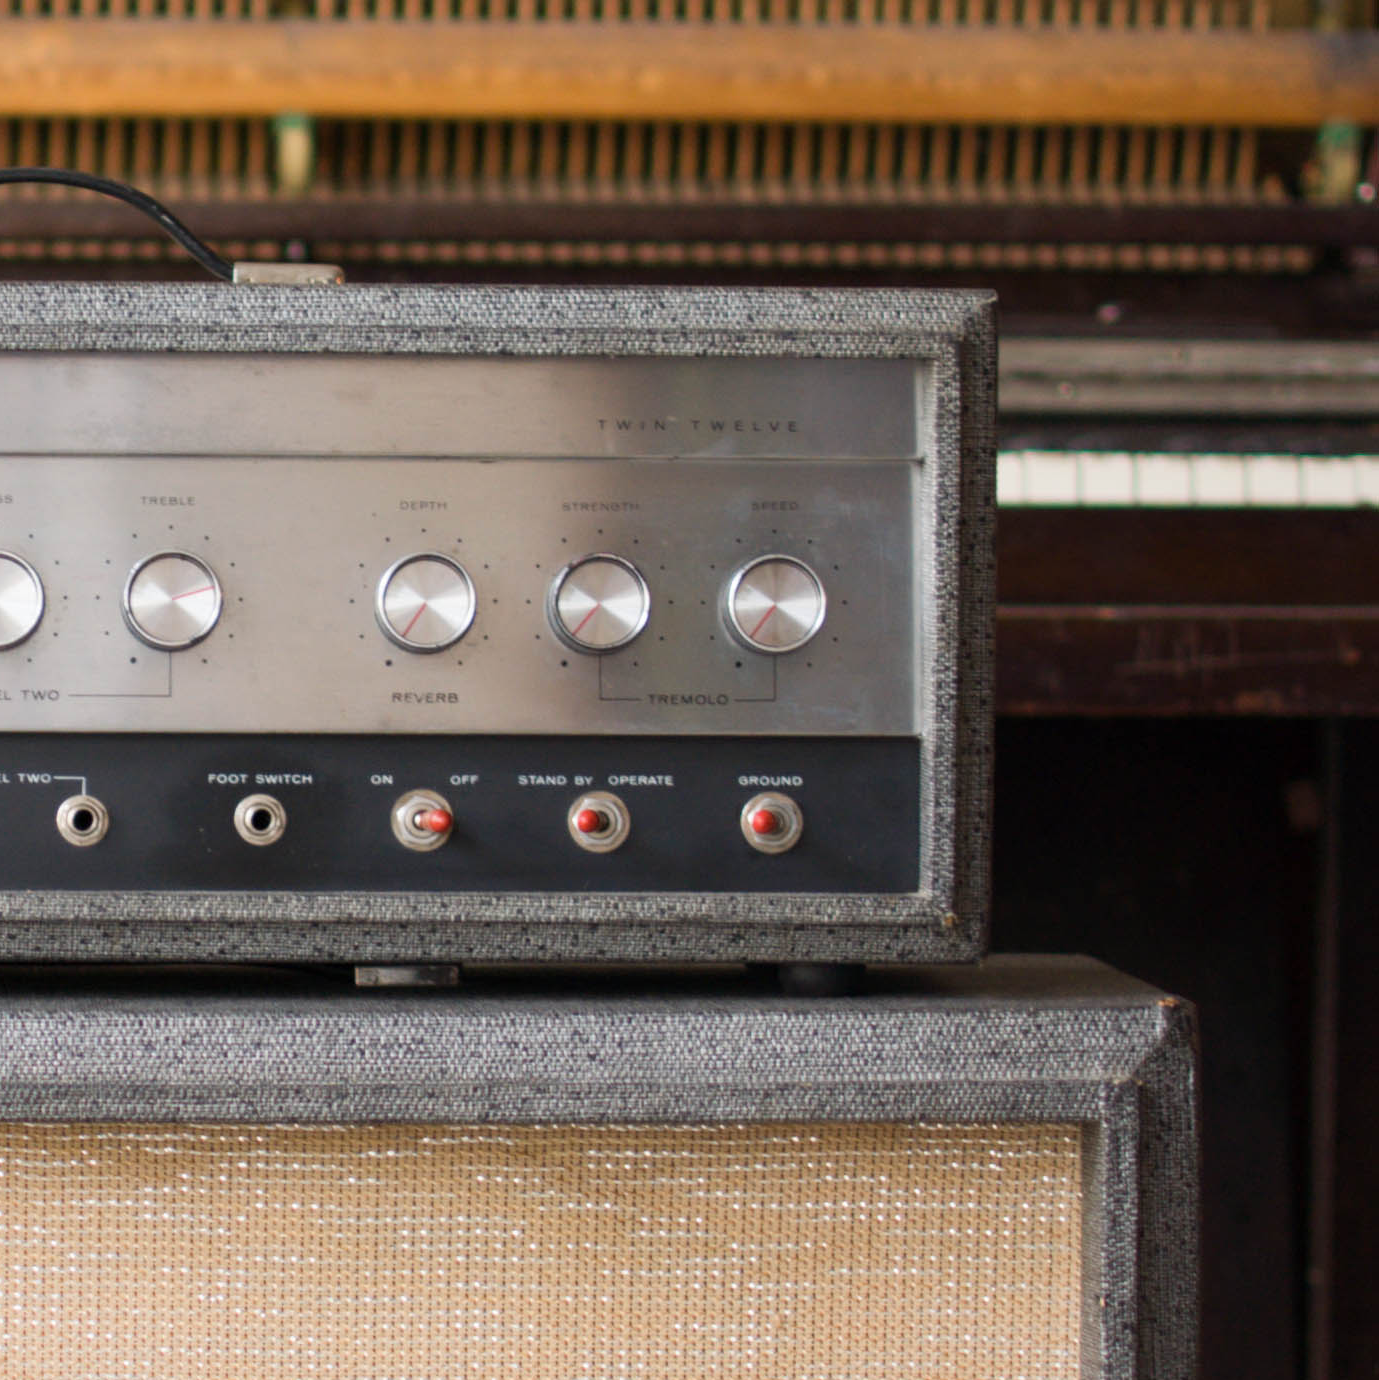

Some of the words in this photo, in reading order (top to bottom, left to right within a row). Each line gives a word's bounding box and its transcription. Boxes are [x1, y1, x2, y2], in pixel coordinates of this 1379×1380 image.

[598, 419, 666, 432] TWIN
[691, 419, 800, 433] TWELVE
[141, 495, 196, 507] TREBLE
[399, 499, 448, 511] DEPTH
[561, 501, 640, 512] STRENGTH
[751, 500, 799, 511] SPEED
[20, 688, 60, 701] TWO
[391, 691, 460, 704] REVERB
[648, 693, 729, 705] TREMOLO
[17, 772, 52, 784] TWO
[208, 773, 248, 784] FOOT
[255, 773, 313, 785] SWITCH
[370, 774, 394, 785] ON
[449, 774, 479, 785] OFF
[518, 774, 567, 785] STAND
[574, 774, 593, 785] BY
[607, 774, 674, 786] OPERATE
[737, 774, 803, 786] GROUND
